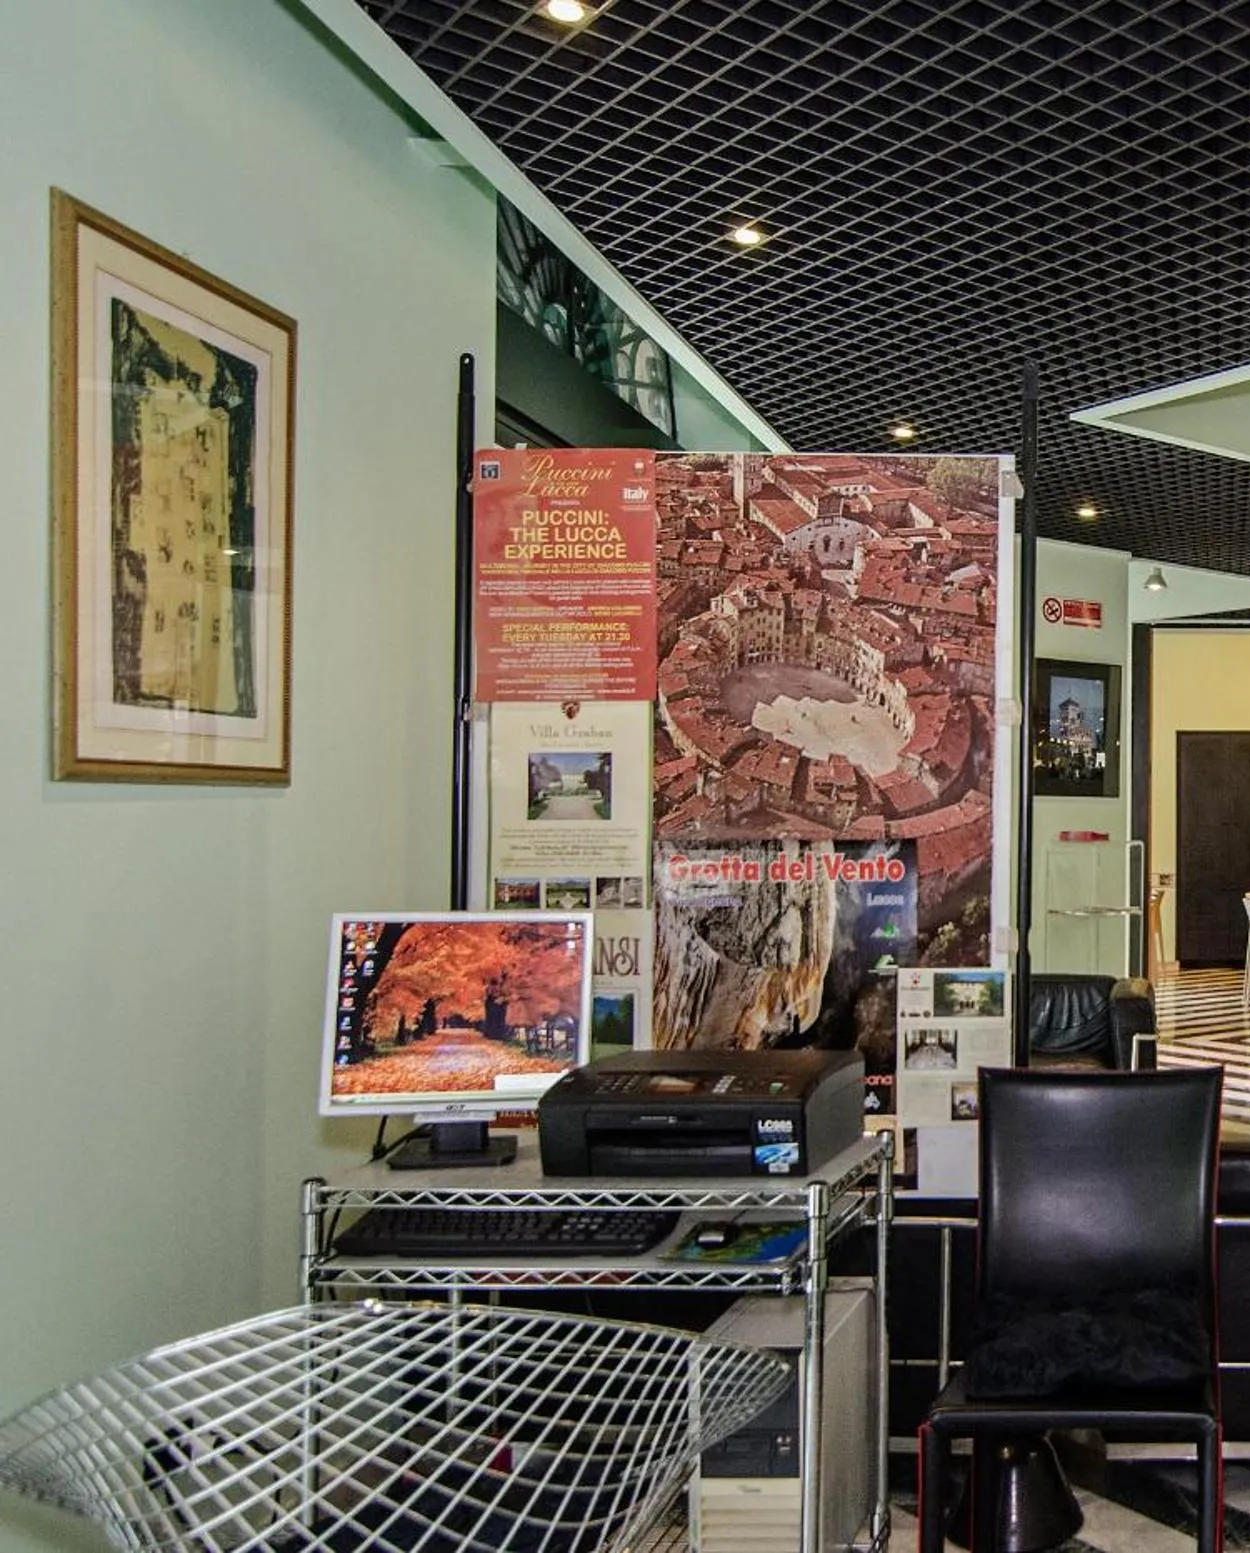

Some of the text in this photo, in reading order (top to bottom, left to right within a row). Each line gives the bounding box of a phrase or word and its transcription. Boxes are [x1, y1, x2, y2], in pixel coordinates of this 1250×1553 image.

[521, 454, 614, 481] Puccini
[522, 510, 610, 525] PUCCINI:
[510, 527, 622, 542] THE LUCCA
[504, 544, 628, 559] EXPERIENCE
[502, 622, 545, 632] SPECIAL
[502, 632, 537, 642] EVERY
[540, 632, 588, 641] TUESDAY
[589, 632, 604, 641] AT
[530, 724, 560, 738] Villa
[668, 852, 906, 882] Grotta del Vento
[592, 936, 641, 976] NSI
